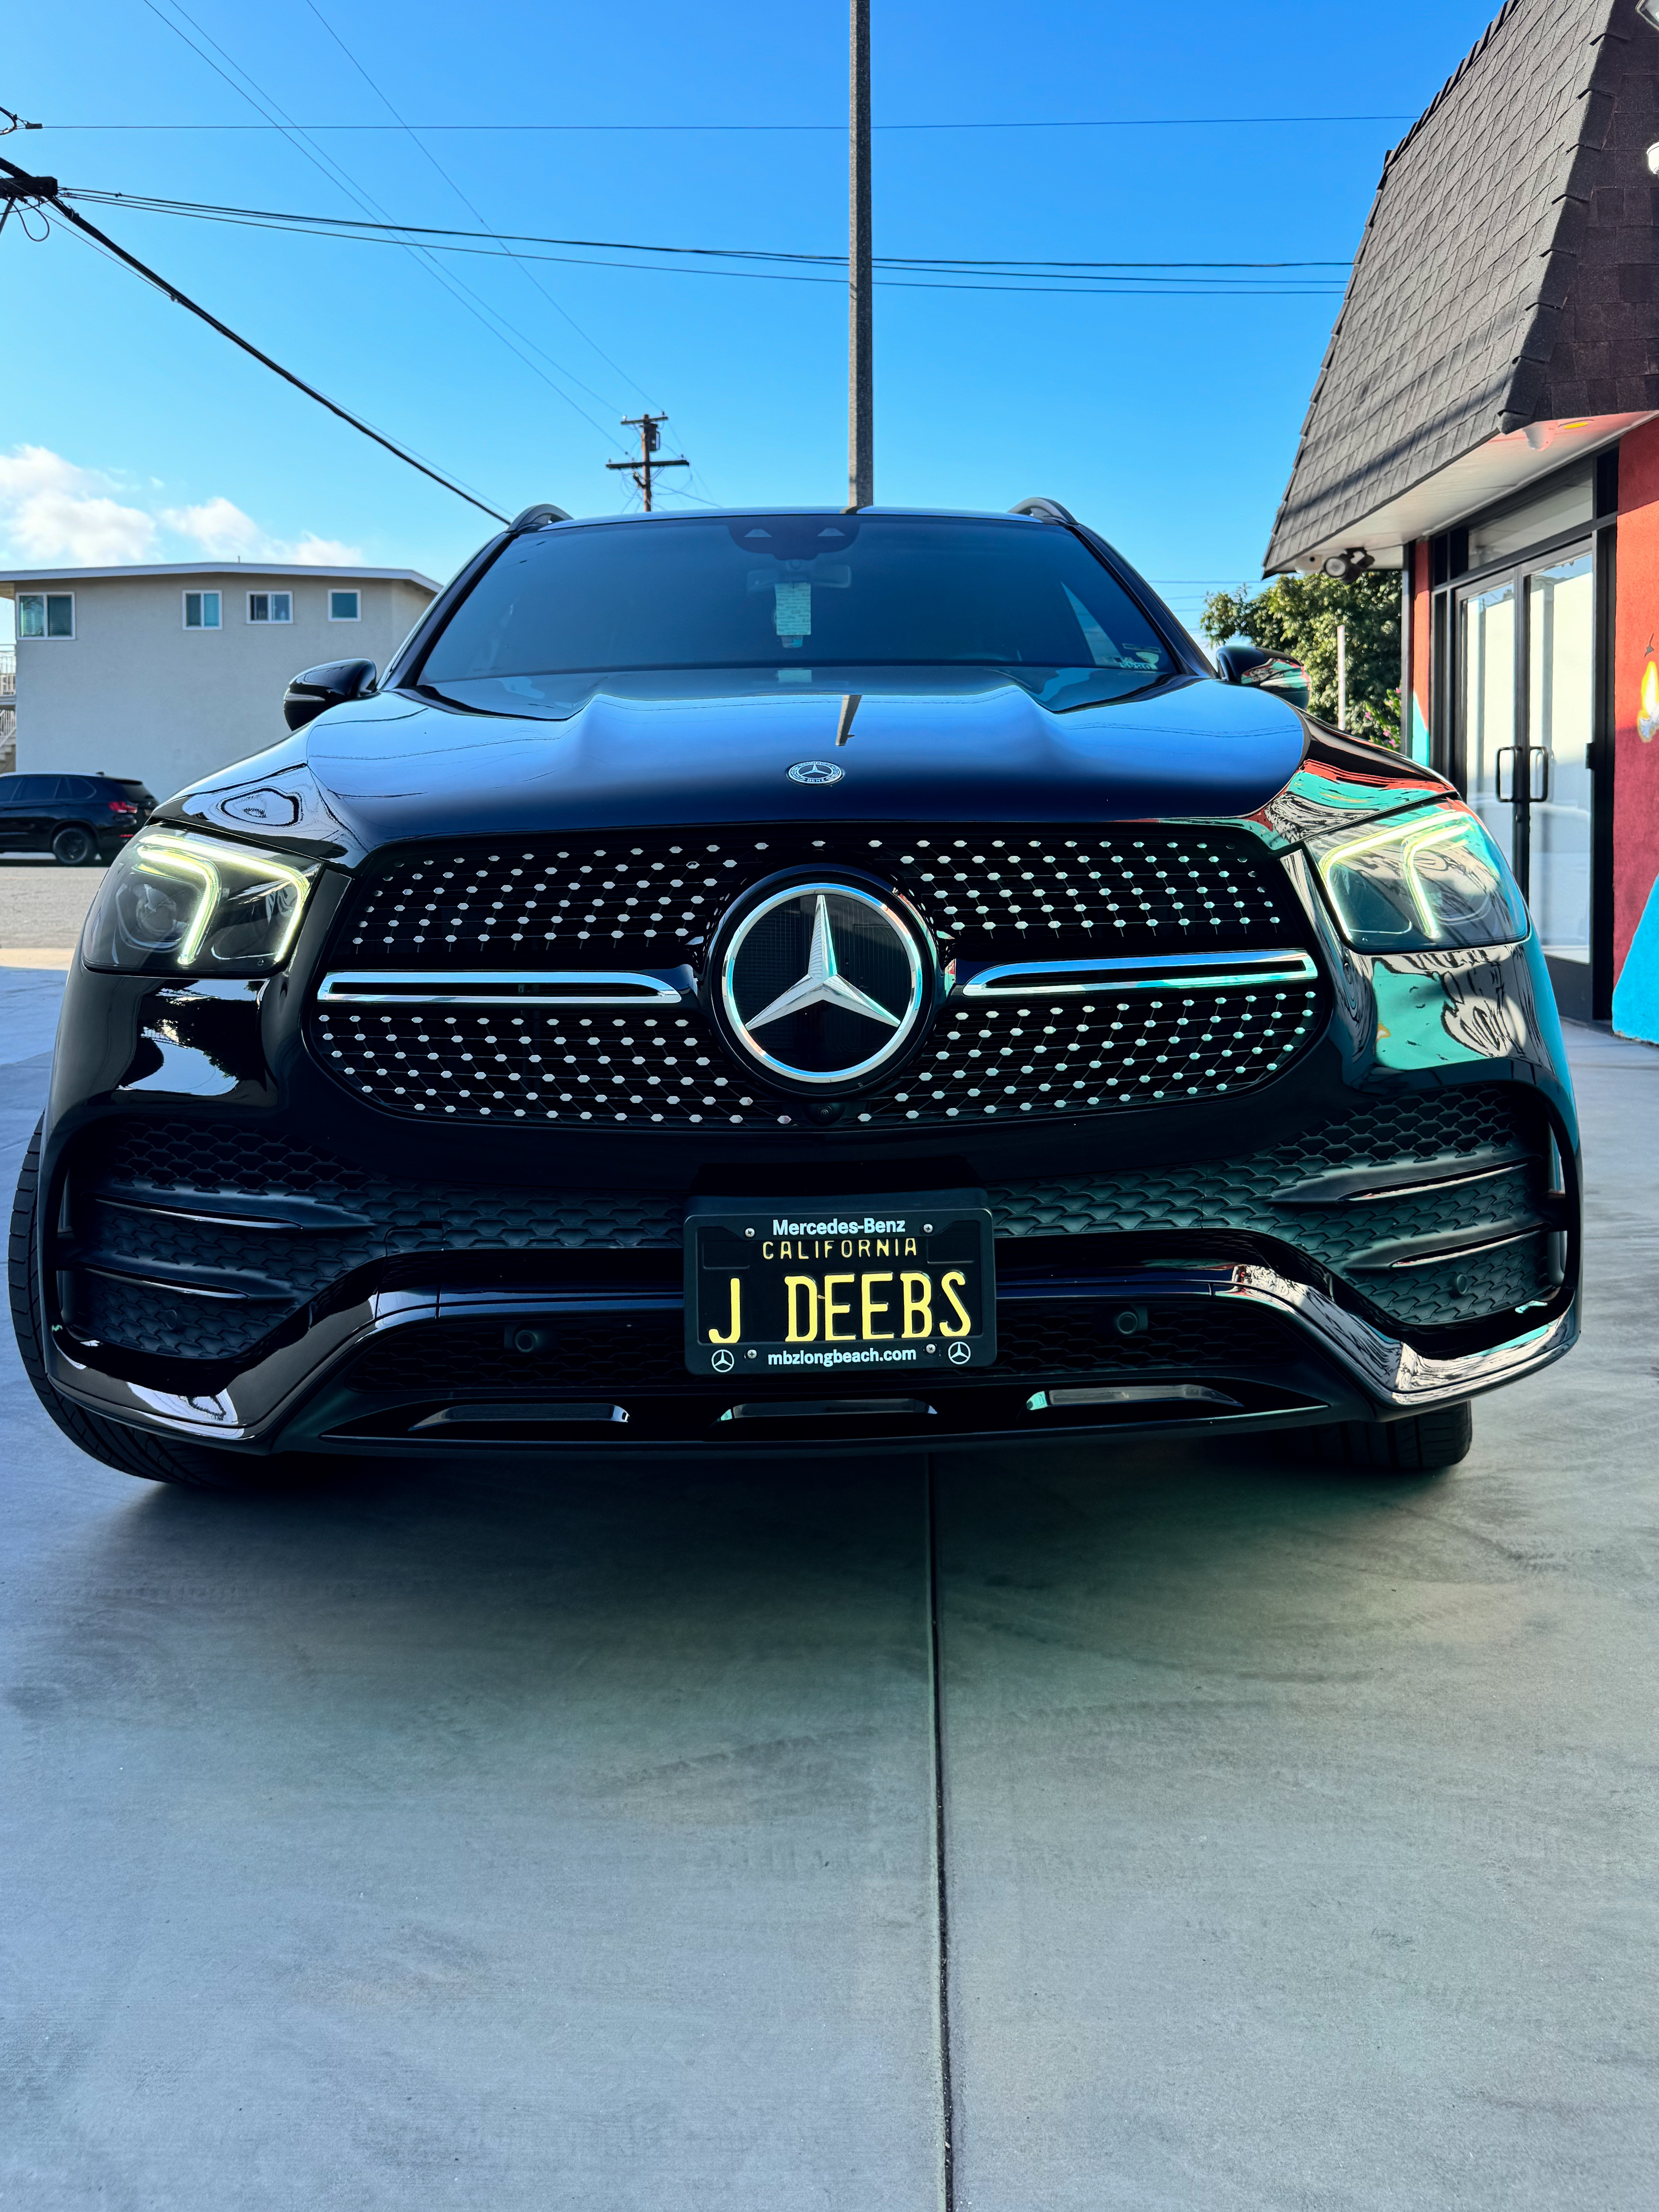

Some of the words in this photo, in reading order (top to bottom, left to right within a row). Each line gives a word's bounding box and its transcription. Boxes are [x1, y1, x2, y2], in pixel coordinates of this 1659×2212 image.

[773, 1218, 905, 1235] Mercedes-Benz
[763, 1238, 917, 1259] CALIFORNIA
[709, 1278, 741, 1343] J
[785, 1271, 971, 1342] DEEBS
[768, 1348, 917, 1367] mbzlongbeach.com
